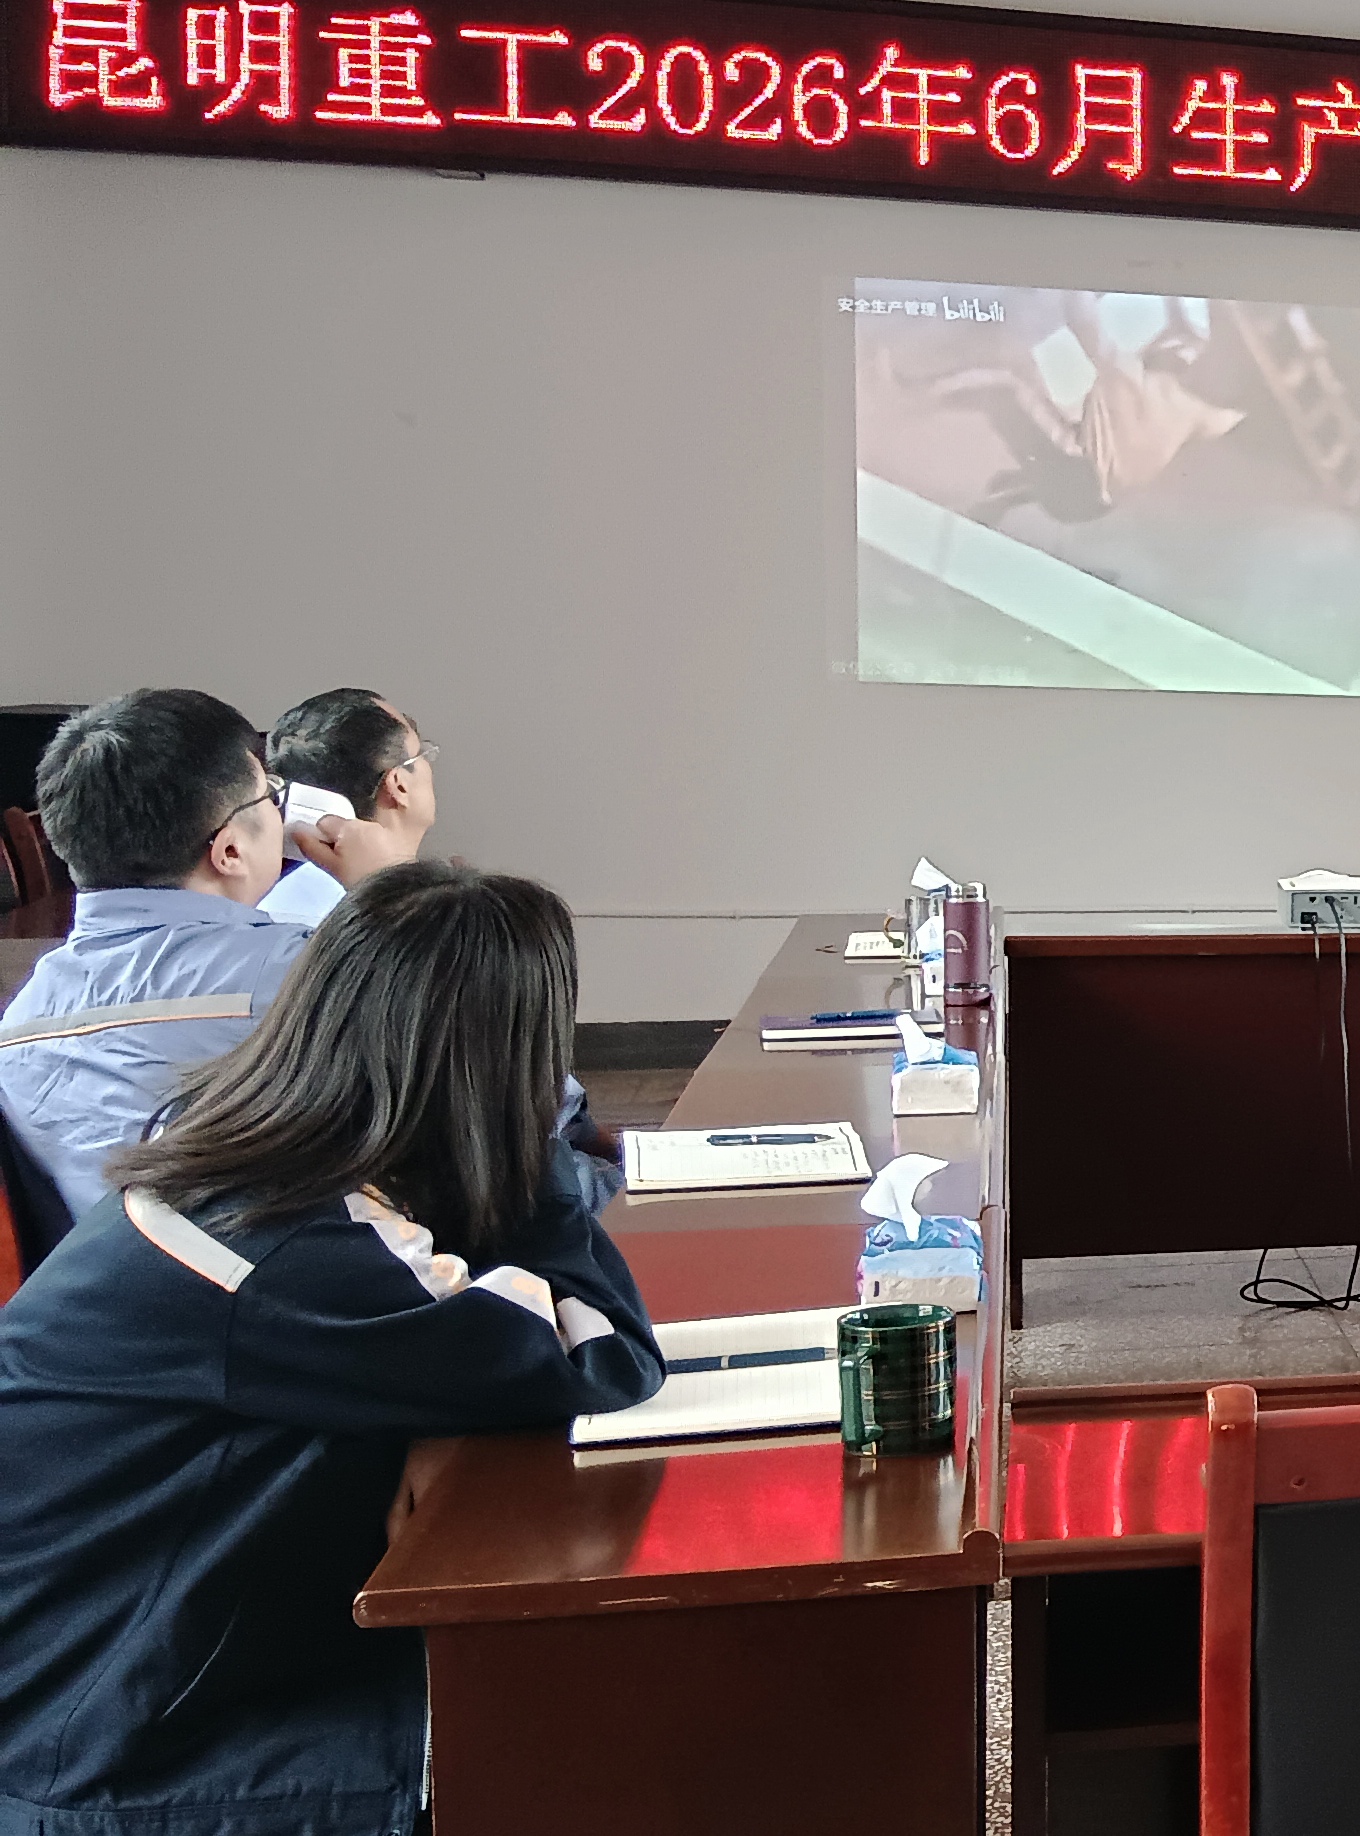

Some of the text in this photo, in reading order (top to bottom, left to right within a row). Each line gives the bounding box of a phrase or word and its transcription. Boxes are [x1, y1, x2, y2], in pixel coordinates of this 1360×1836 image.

[837, 297, 937, 317] 安全生产管理
[943, 295, 1005, 323] bilibili
